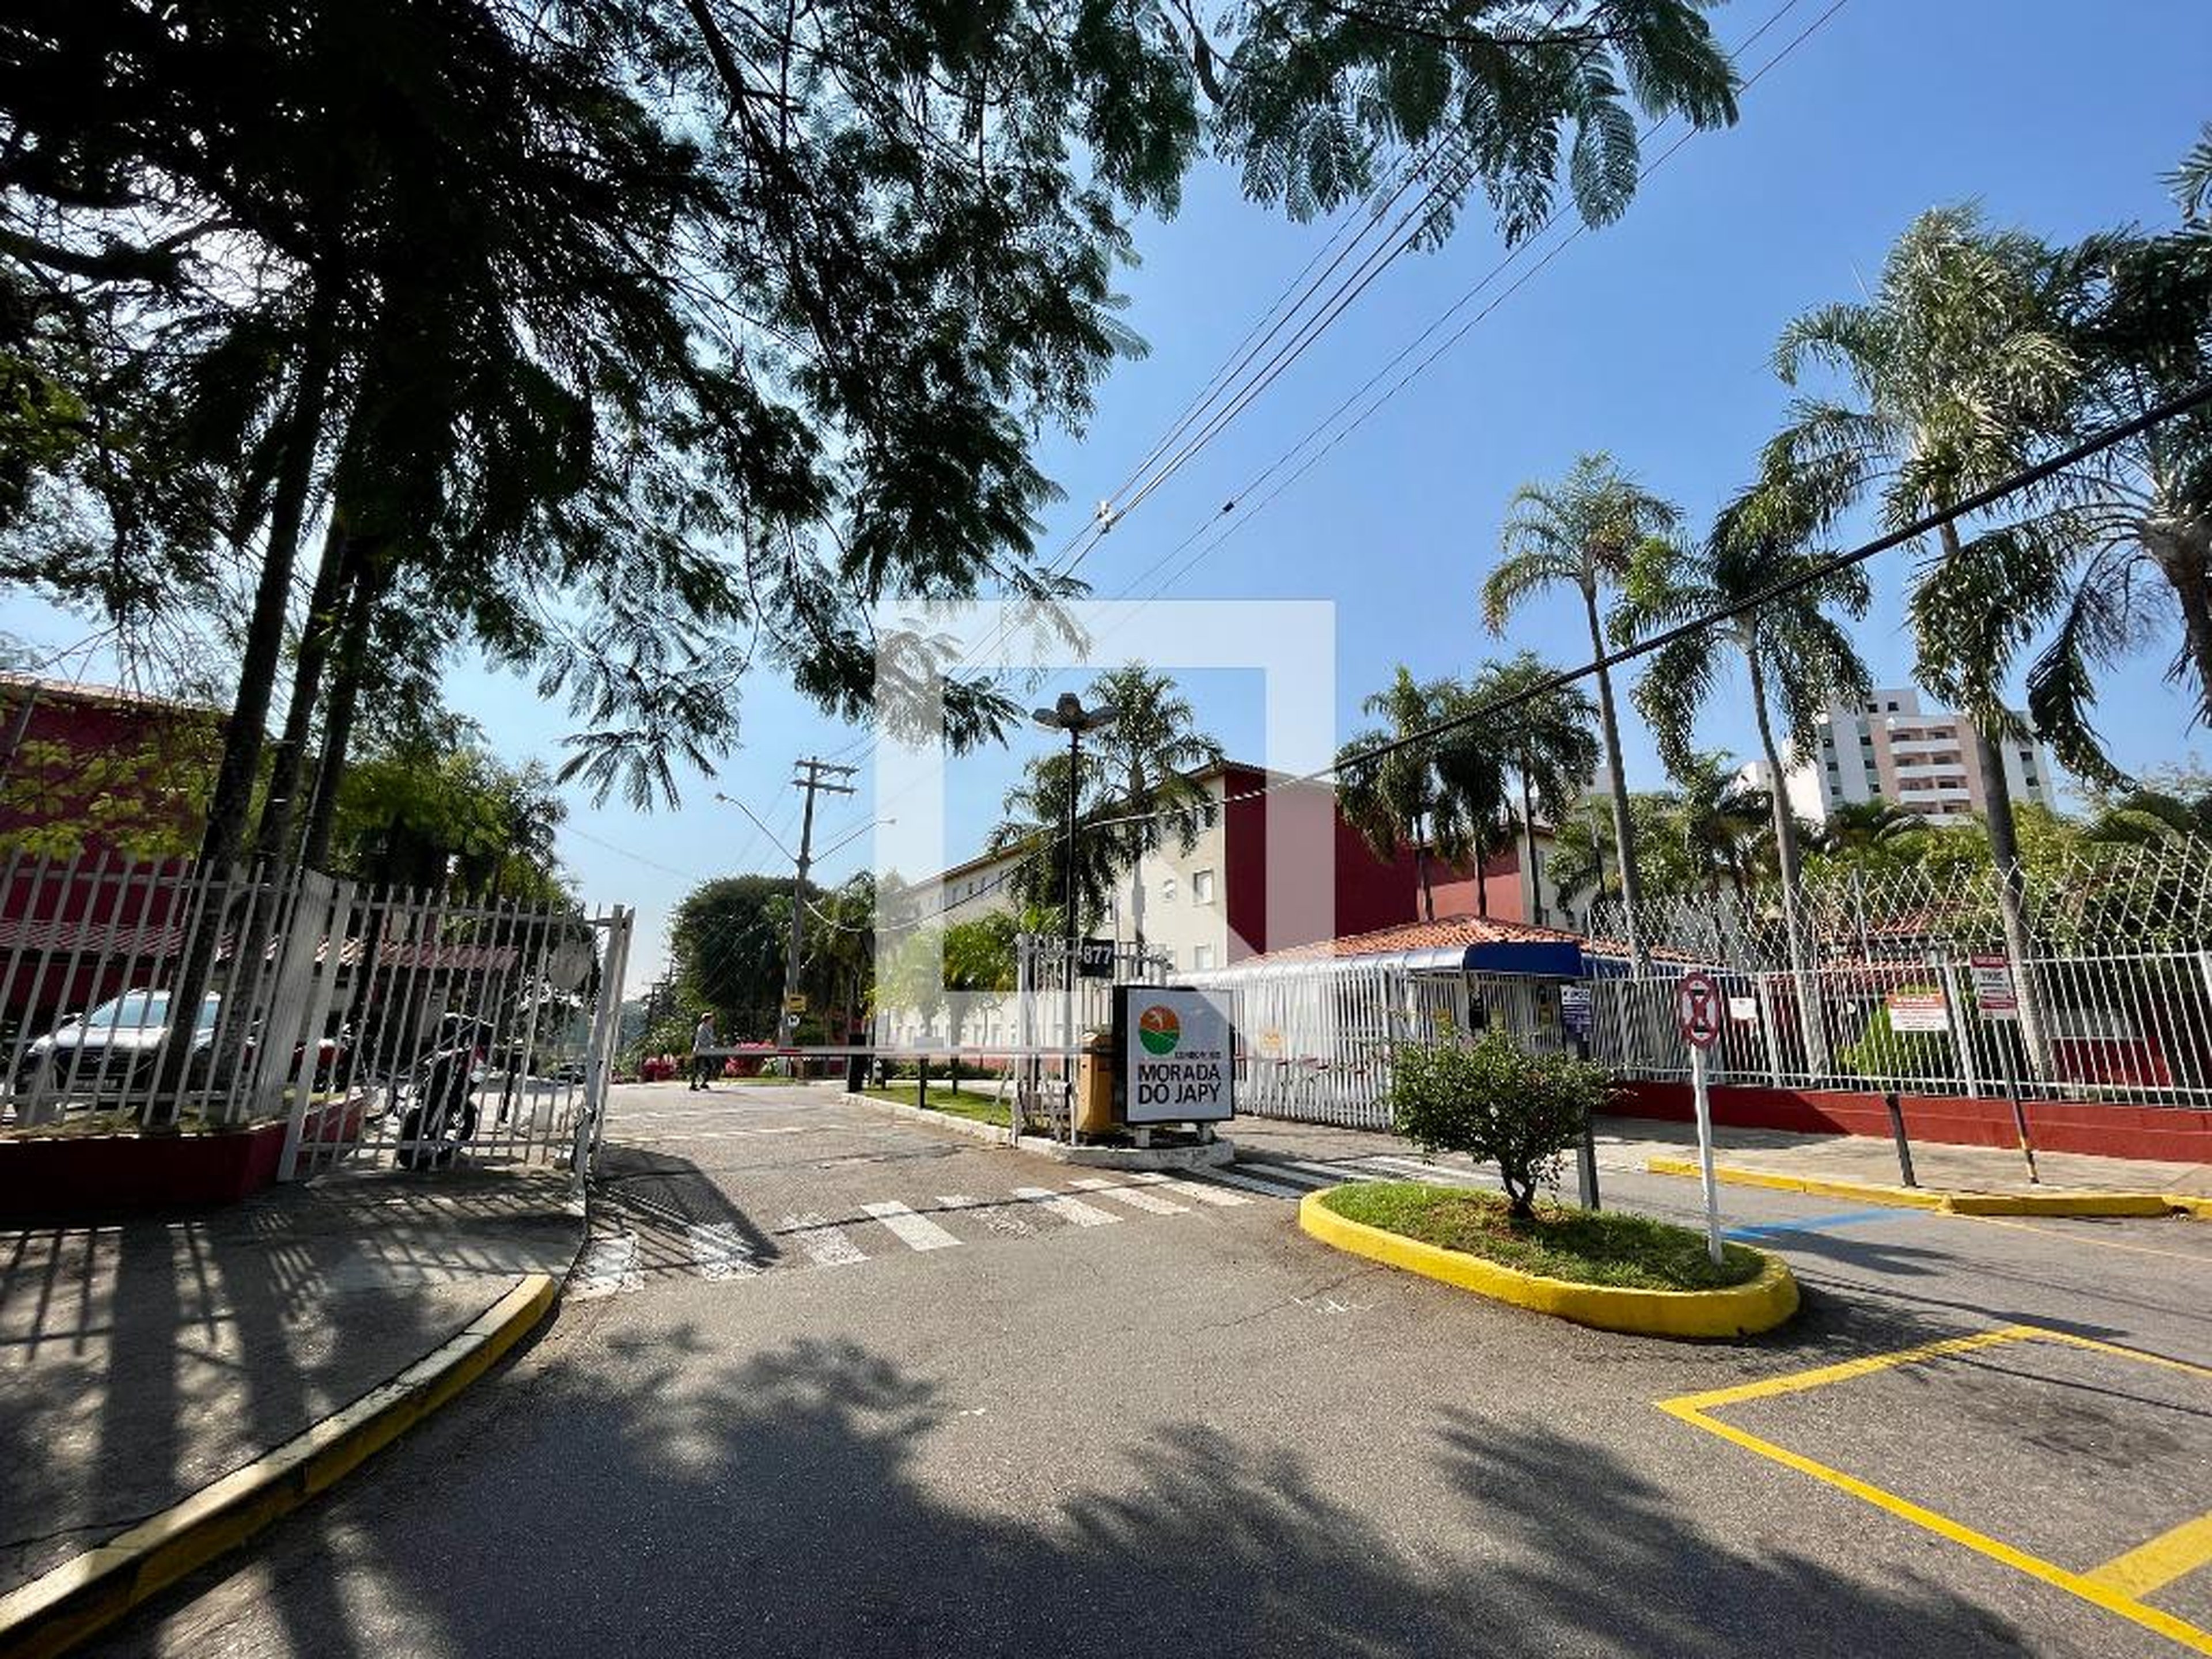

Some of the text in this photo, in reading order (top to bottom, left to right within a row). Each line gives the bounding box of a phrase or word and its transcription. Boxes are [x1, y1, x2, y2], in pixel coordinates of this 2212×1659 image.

[1084, 945, 1112, 964] 877
[1138, 1064, 1221, 1082] MORADA
[1139, 1082, 1221, 1104] DO JAPY
